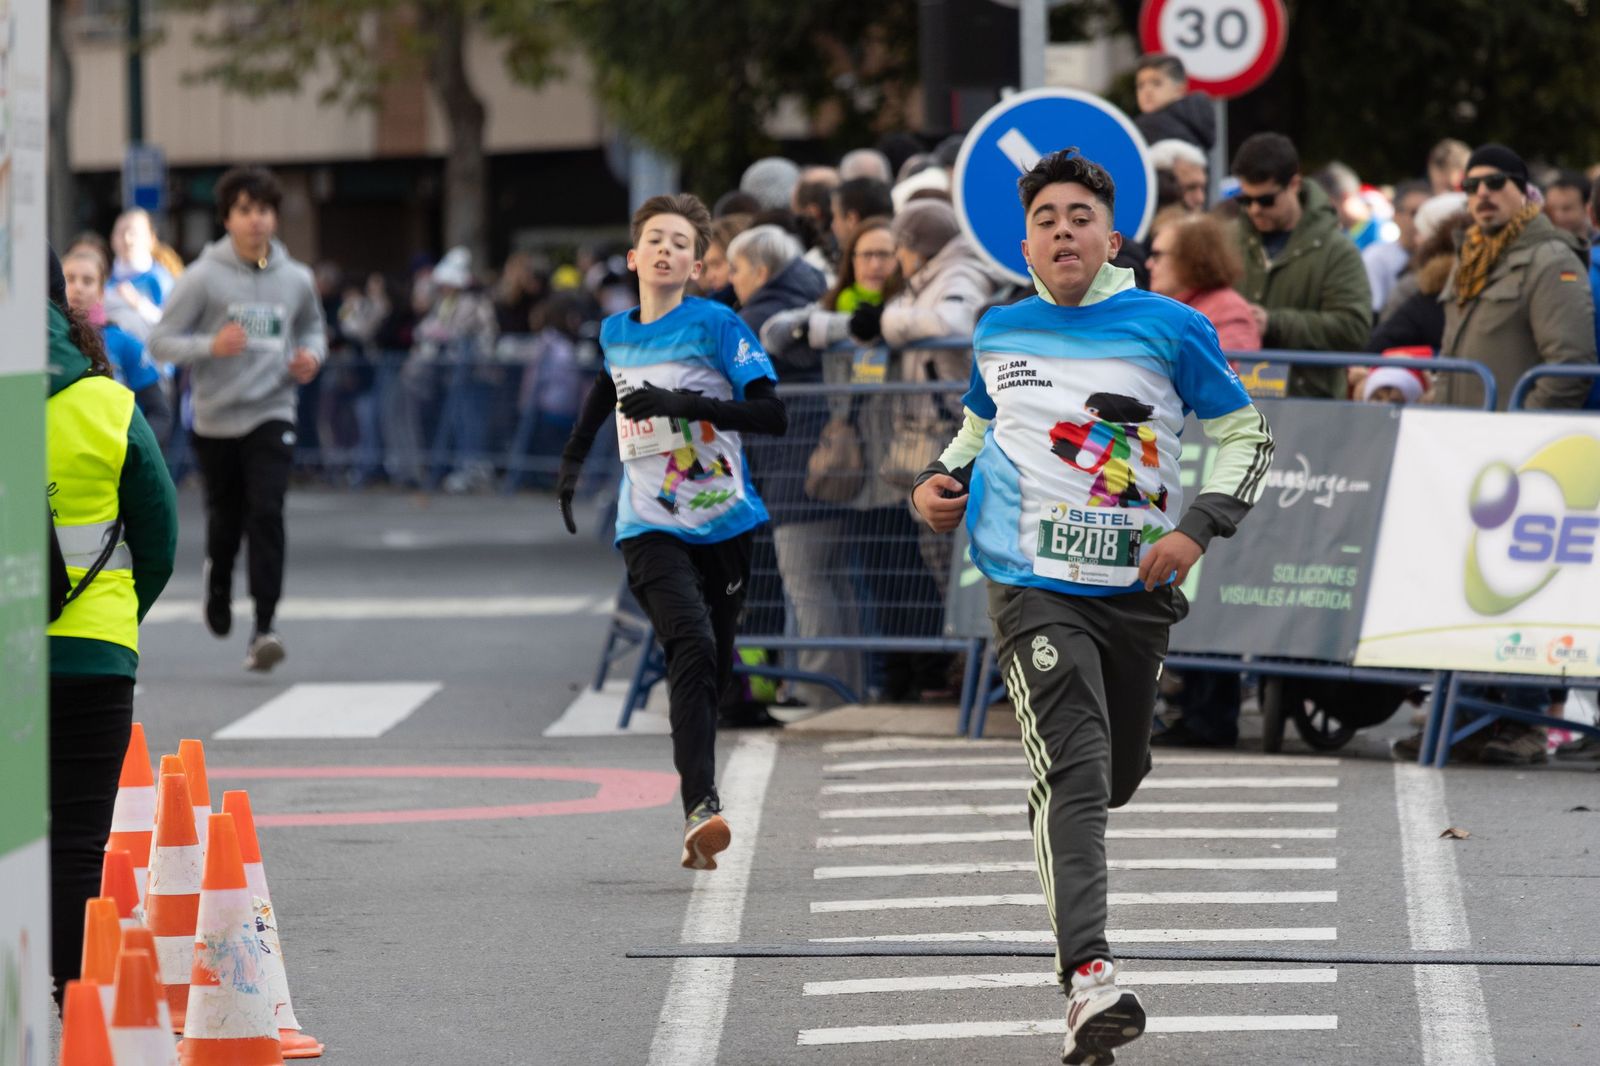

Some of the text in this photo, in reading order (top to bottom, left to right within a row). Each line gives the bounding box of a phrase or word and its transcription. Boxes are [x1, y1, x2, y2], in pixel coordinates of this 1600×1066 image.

[1176, 8, 1248, 49] 30
[997, 369, 1037, 381] SILVESTRE
[1009, 360, 1027, 369] SAN
[997, 379, 1053, 391] SALMANTINA
[1069, 509, 1133, 526] SETEL
[1051, 523, 1119, 560] 6208
[1508, 514, 1600, 564] SE
[1272, 562, 1358, 586] SOLUCIONES
[1219, 584, 1353, 610] VISUALES A MEDIDA
